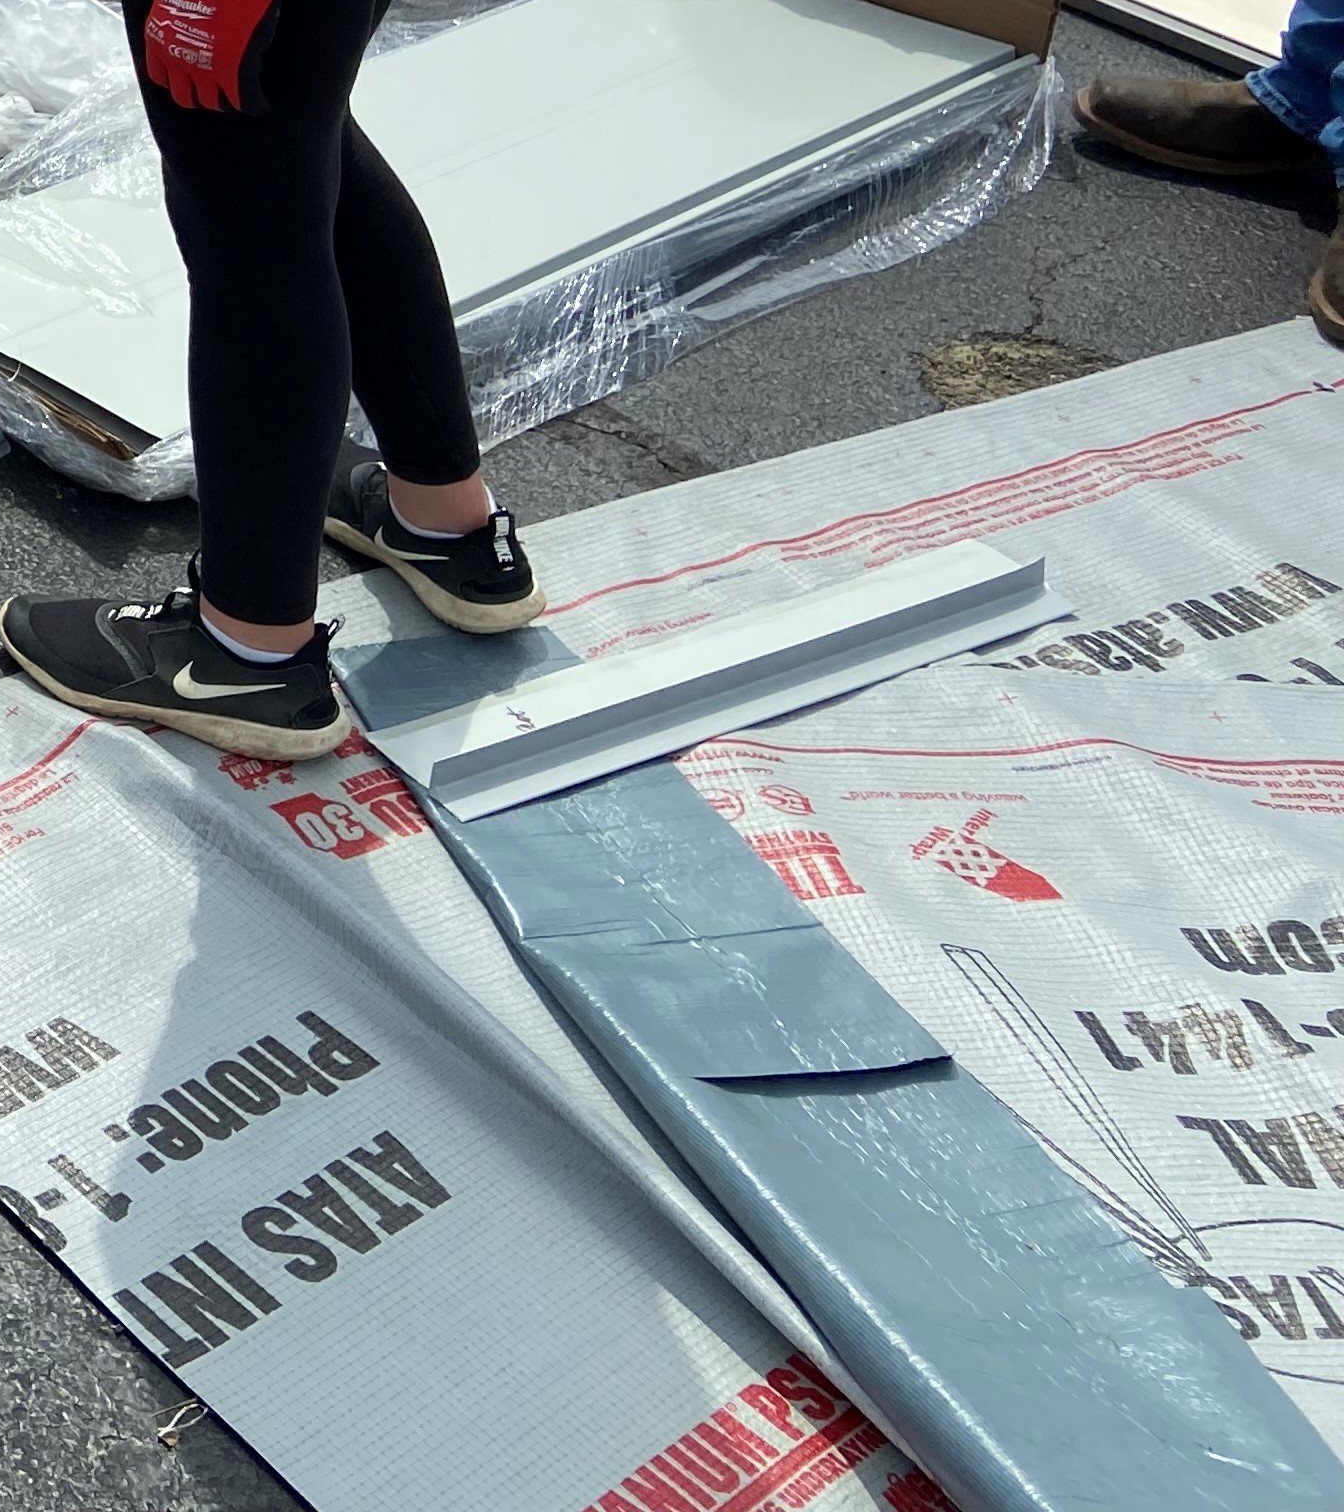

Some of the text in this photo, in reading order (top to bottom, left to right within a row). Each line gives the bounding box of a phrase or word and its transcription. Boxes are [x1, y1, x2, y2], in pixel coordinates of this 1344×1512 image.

[898, 790, 946, 801] better
[960, 807, 997, 837] Inter
[291, 798, 366, 854] 30
[103, 1009, 380, 1175] Phone:
[240, 1129, 452, 1284] ATAS
